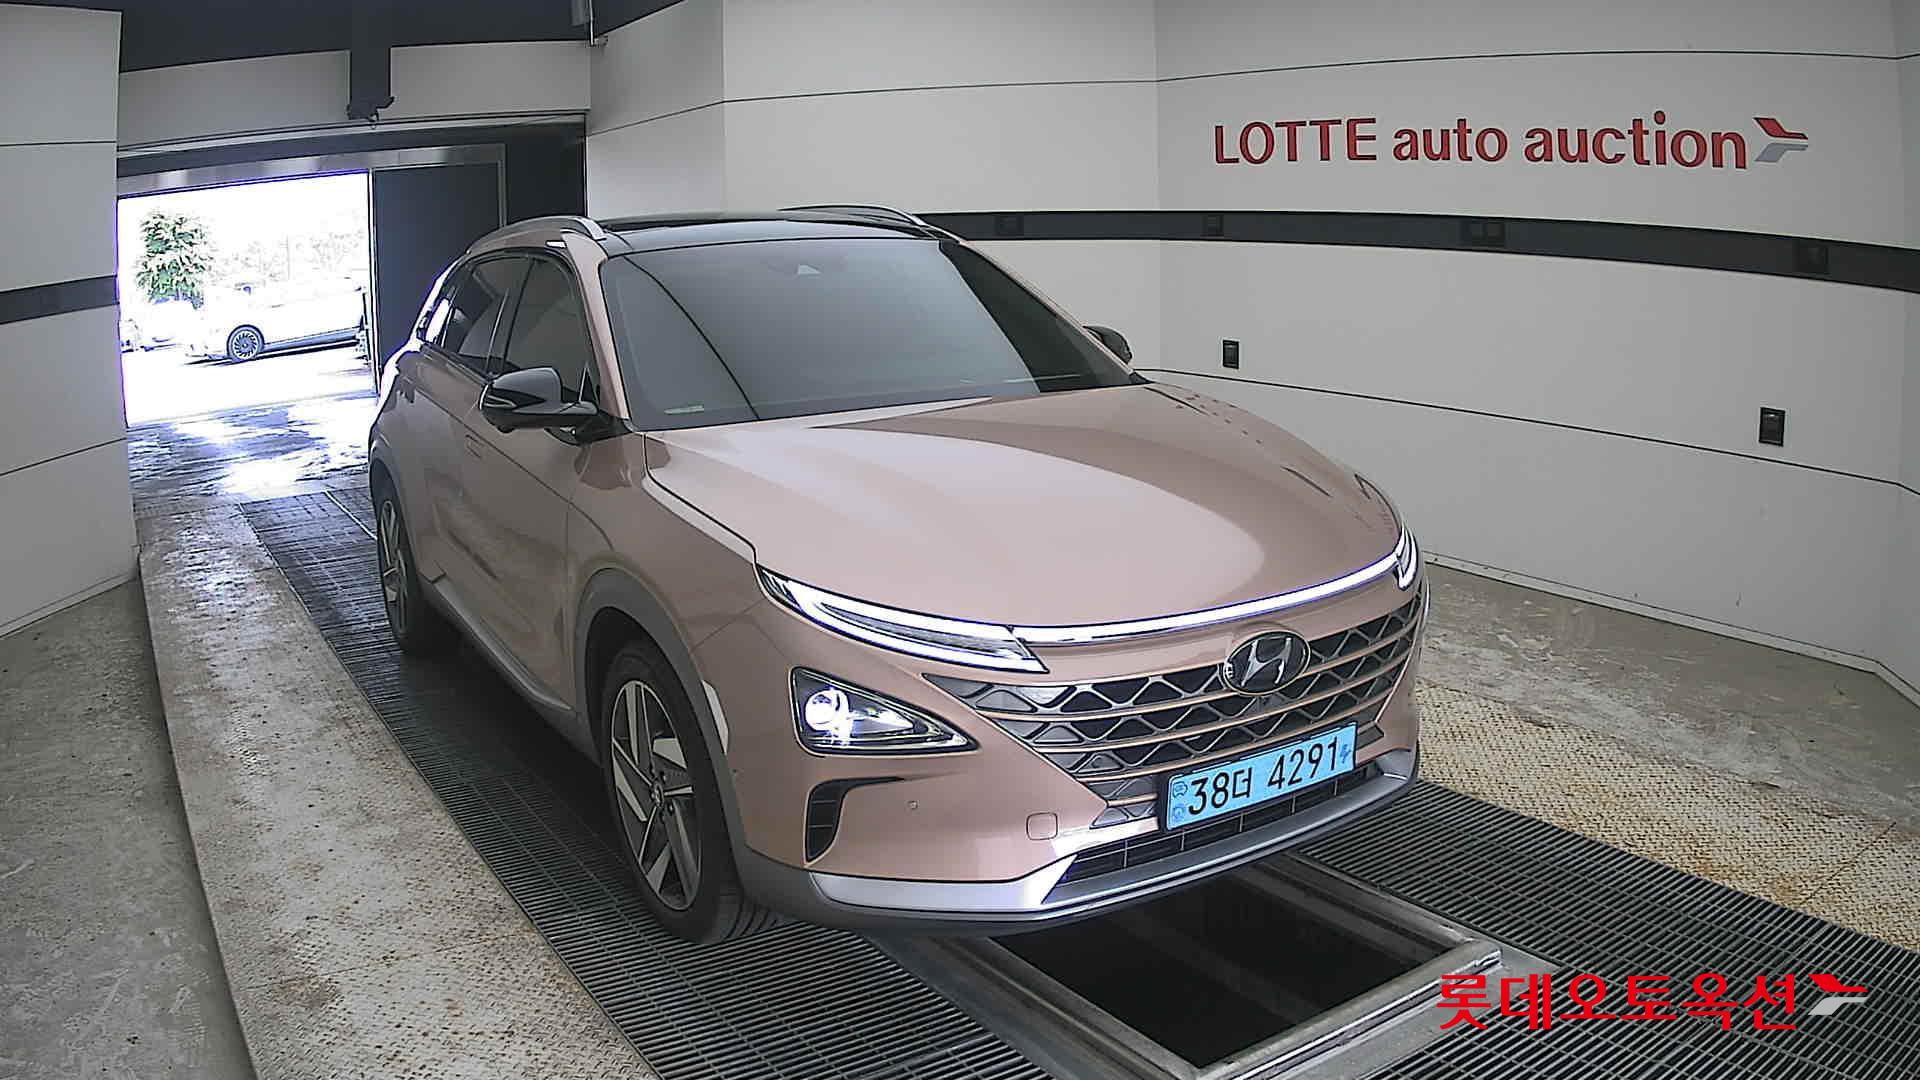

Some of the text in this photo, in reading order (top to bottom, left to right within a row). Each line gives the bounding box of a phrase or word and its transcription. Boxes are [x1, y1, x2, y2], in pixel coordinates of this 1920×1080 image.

[1214, 110, 1748, 169] LOTTE auto auction
[1188, 736, 1338, 815] 38더 4291
